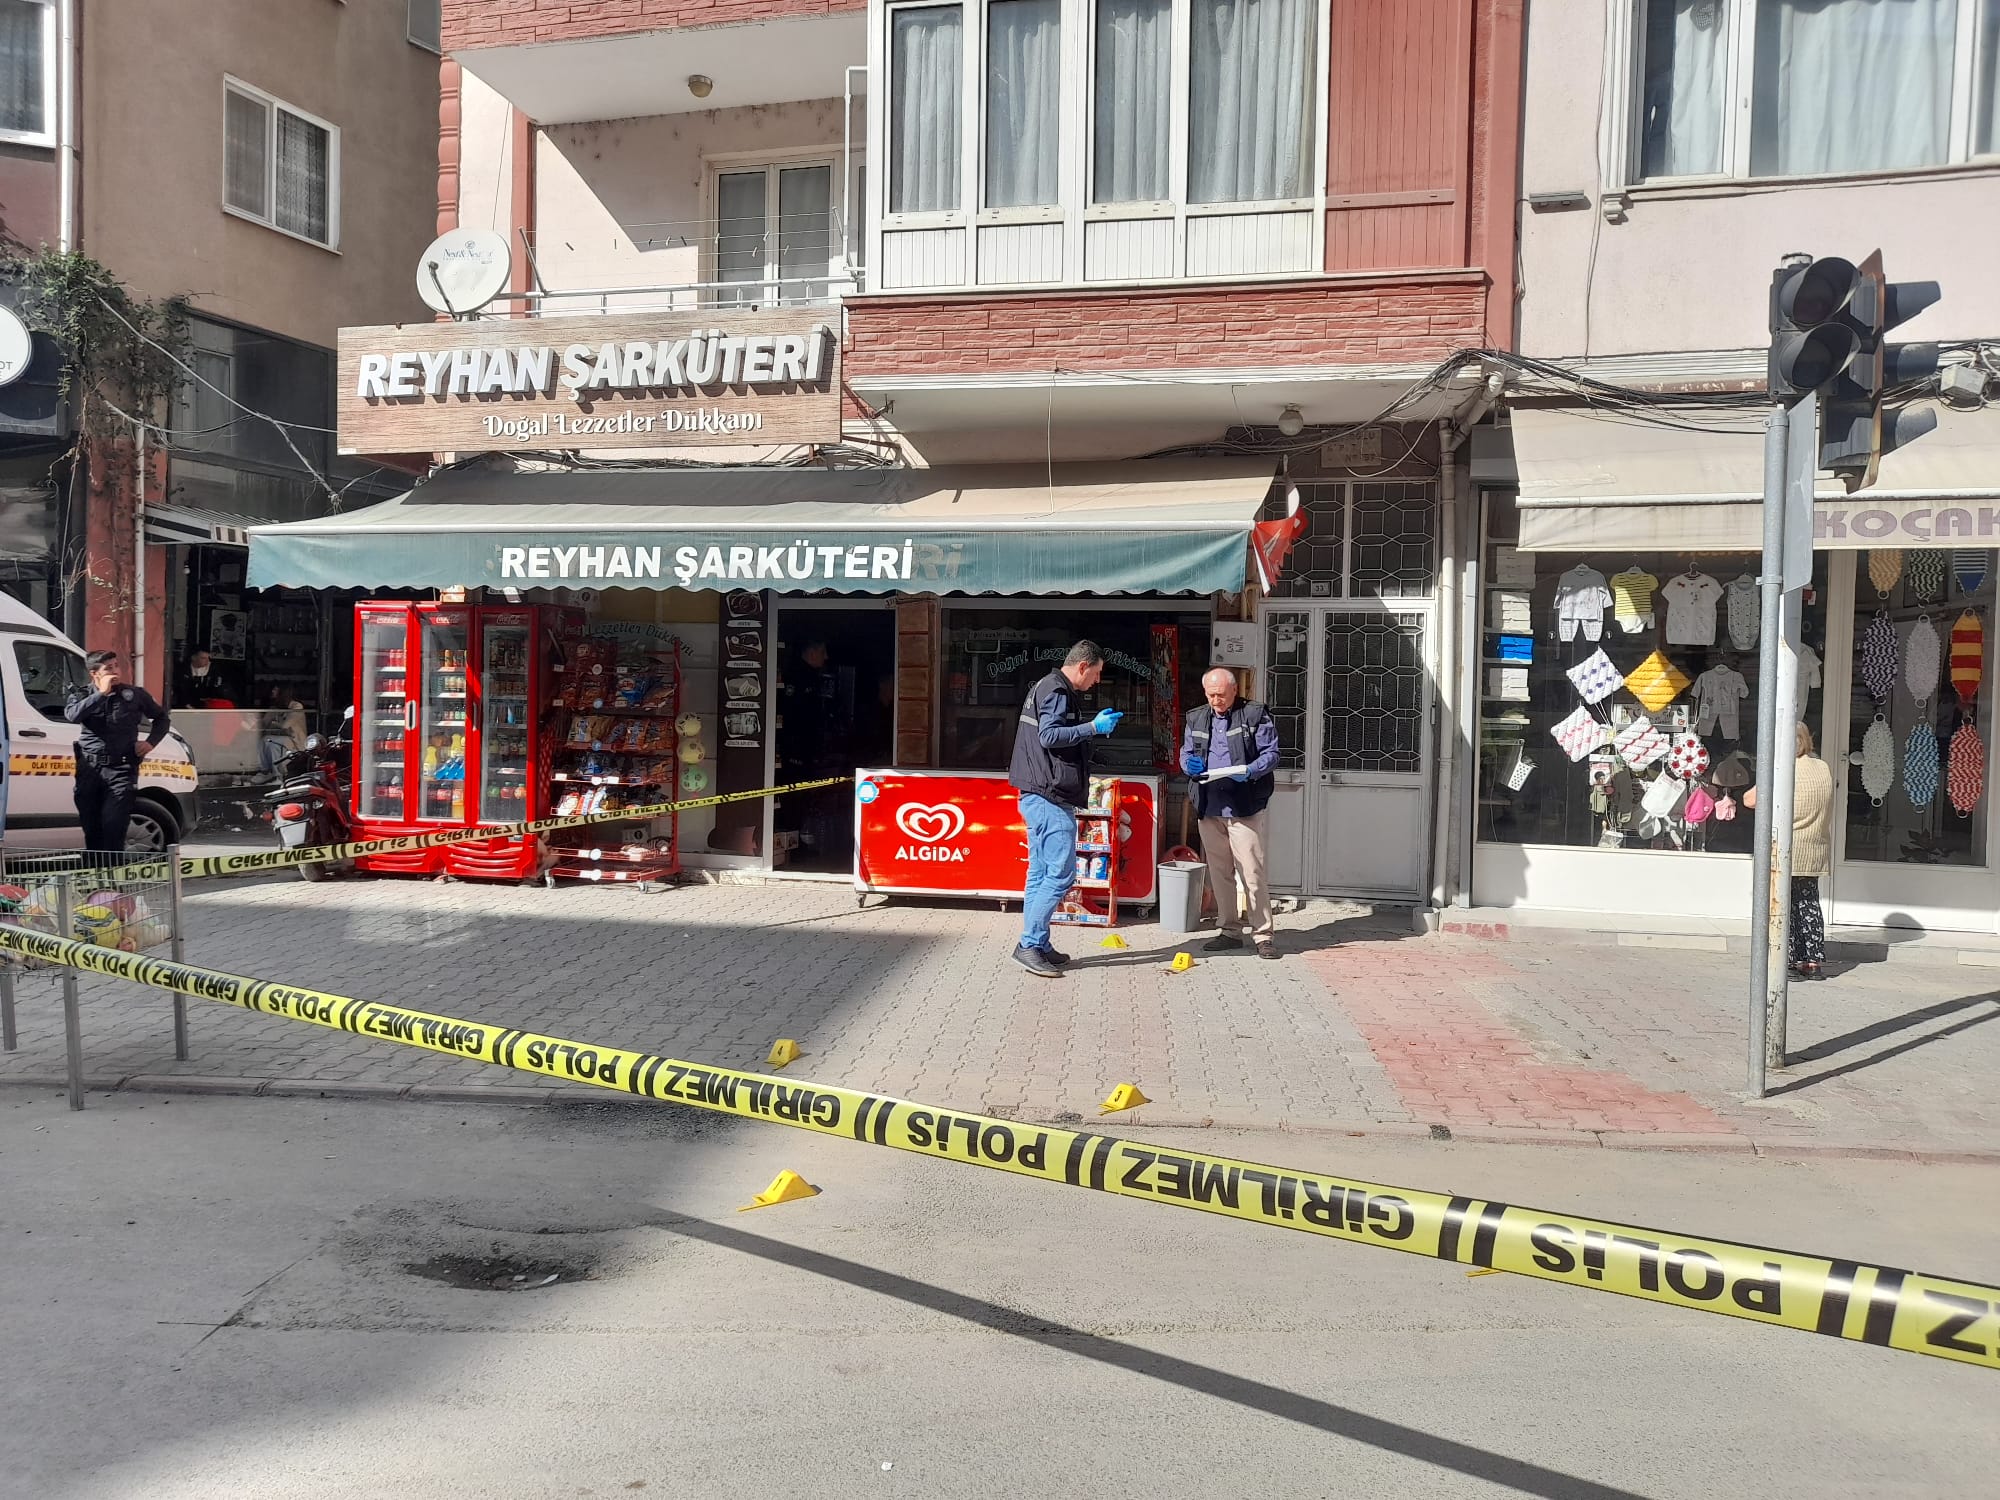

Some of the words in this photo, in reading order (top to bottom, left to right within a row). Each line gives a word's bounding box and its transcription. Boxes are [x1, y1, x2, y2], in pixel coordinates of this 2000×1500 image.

[356, 346, 554, 399] REYHAN
[558, 324, 833, 403] ŞARKÜTERİ
[483, 413, 549, 442] Doğal
[553, 411, 656, 436] Lezzetler
[660, 408, 763, 435] Dükkanı
[1814, 507, 2000, 542] KOÇAK
[501, 546, 662, 579] REYHAN
[674, 538, 914, 587] ŞARKÜTERİ
